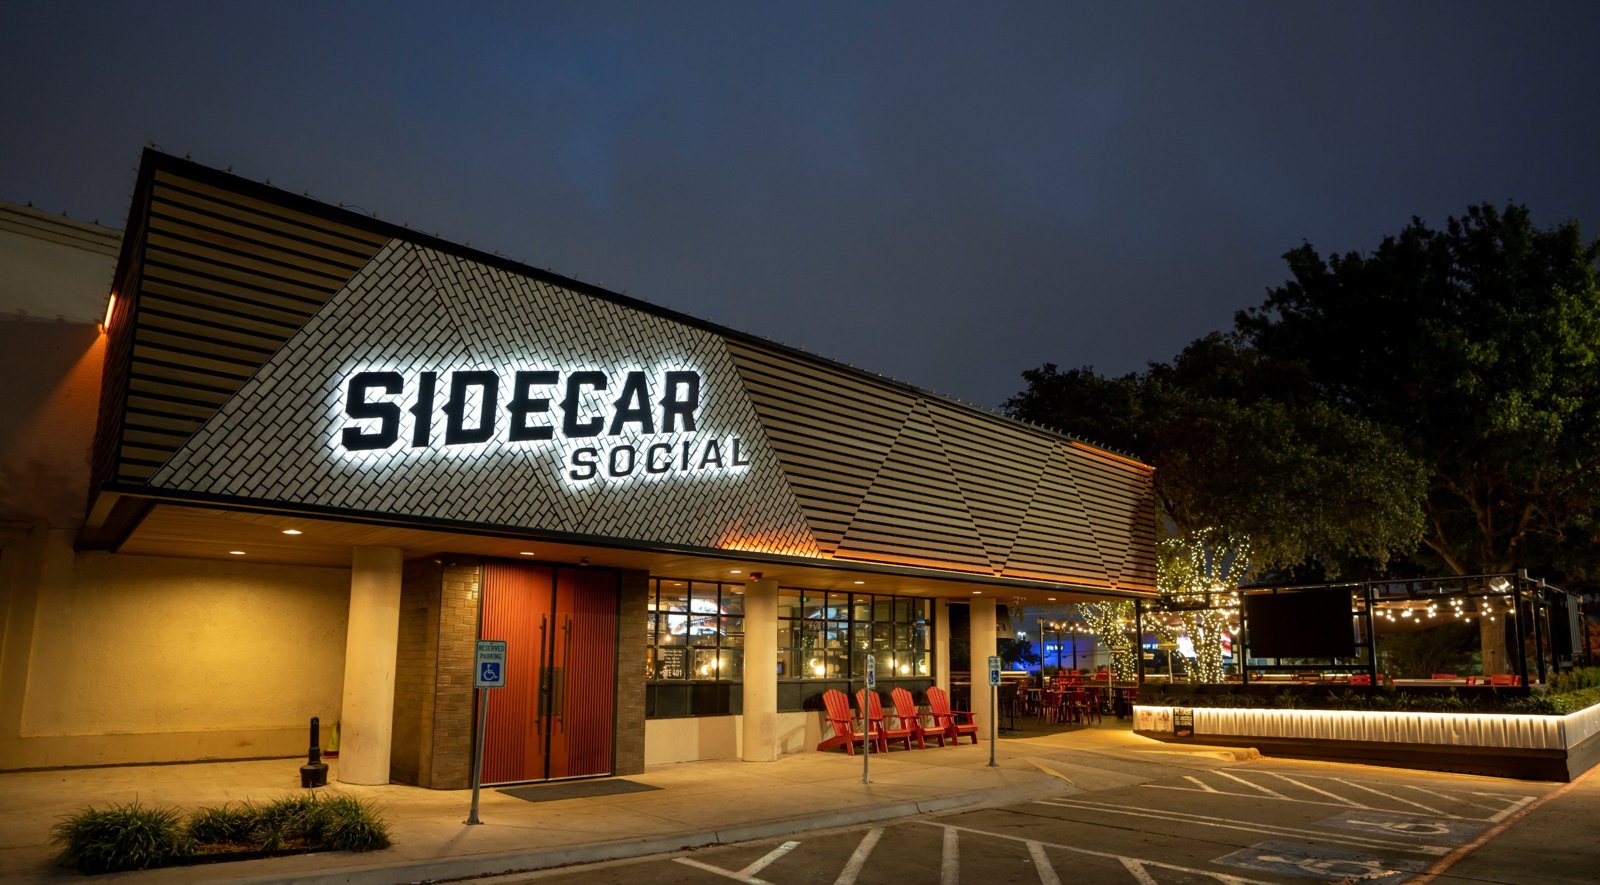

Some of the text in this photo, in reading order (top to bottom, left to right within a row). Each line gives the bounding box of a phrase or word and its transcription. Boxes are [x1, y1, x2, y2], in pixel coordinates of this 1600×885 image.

[342, 370, 701, 452] SIDECAR
[569, 437, 750, 481] SOCIAL
[673, 669, 682, 677] 401
